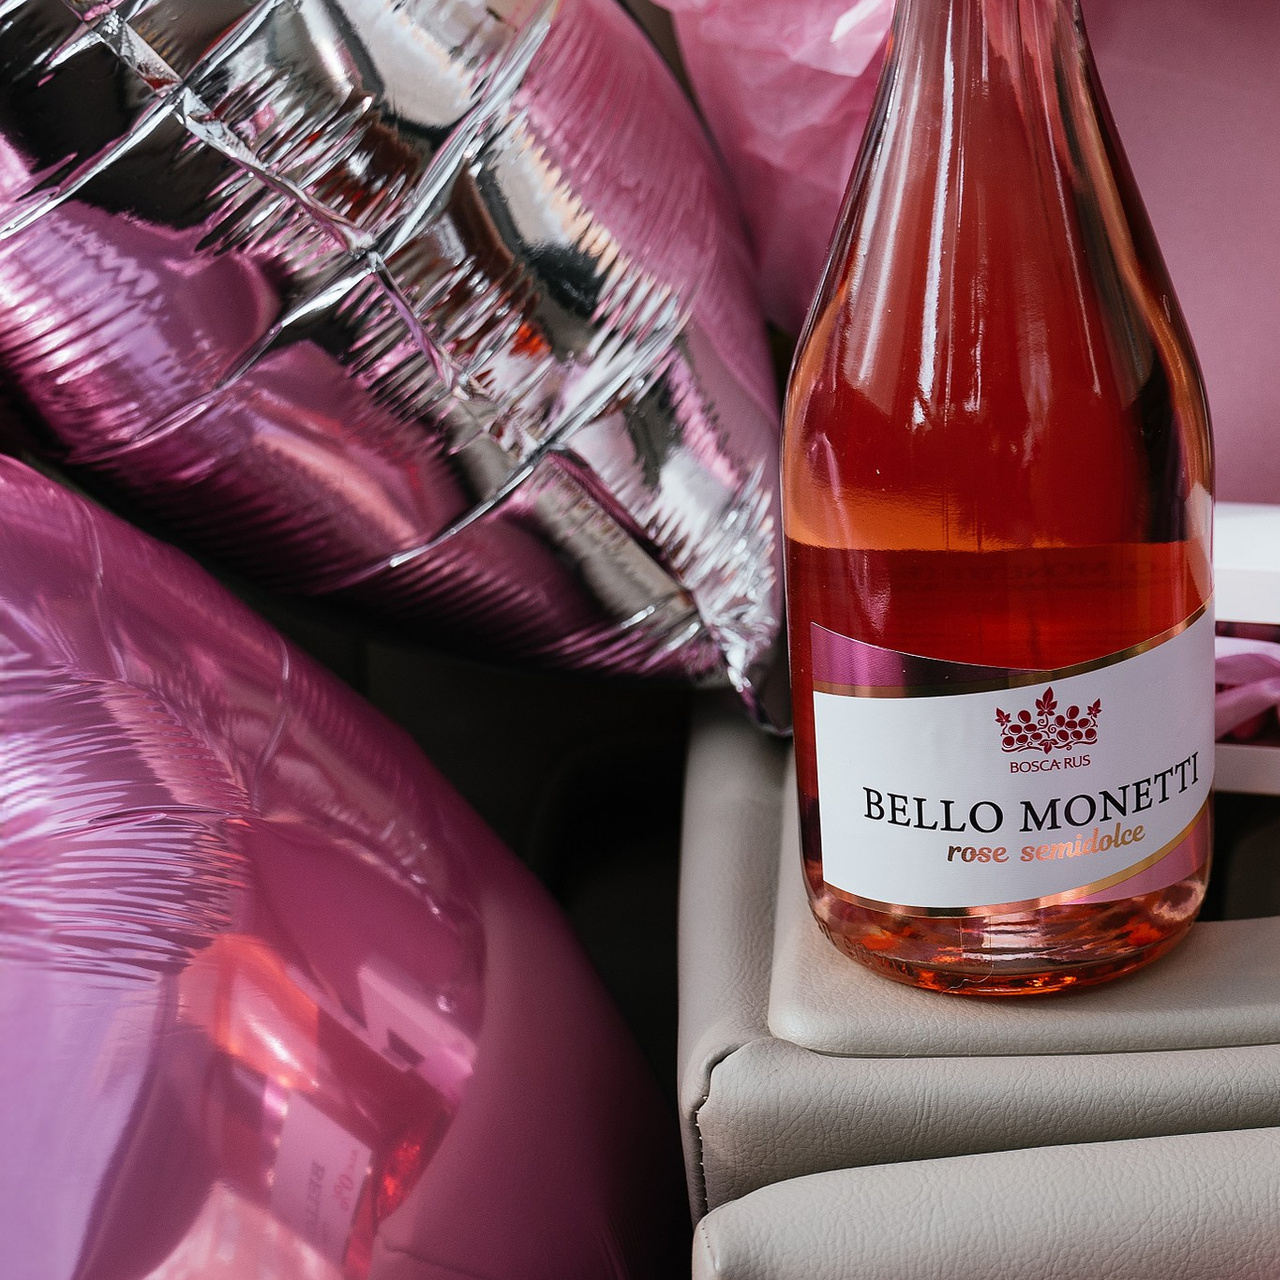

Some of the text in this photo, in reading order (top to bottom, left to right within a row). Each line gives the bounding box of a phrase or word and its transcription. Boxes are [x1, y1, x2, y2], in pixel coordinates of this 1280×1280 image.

[862, 751, 1199, 833] BELLO MONETTI
[947, 821, 1146, 862] rose semidolce
